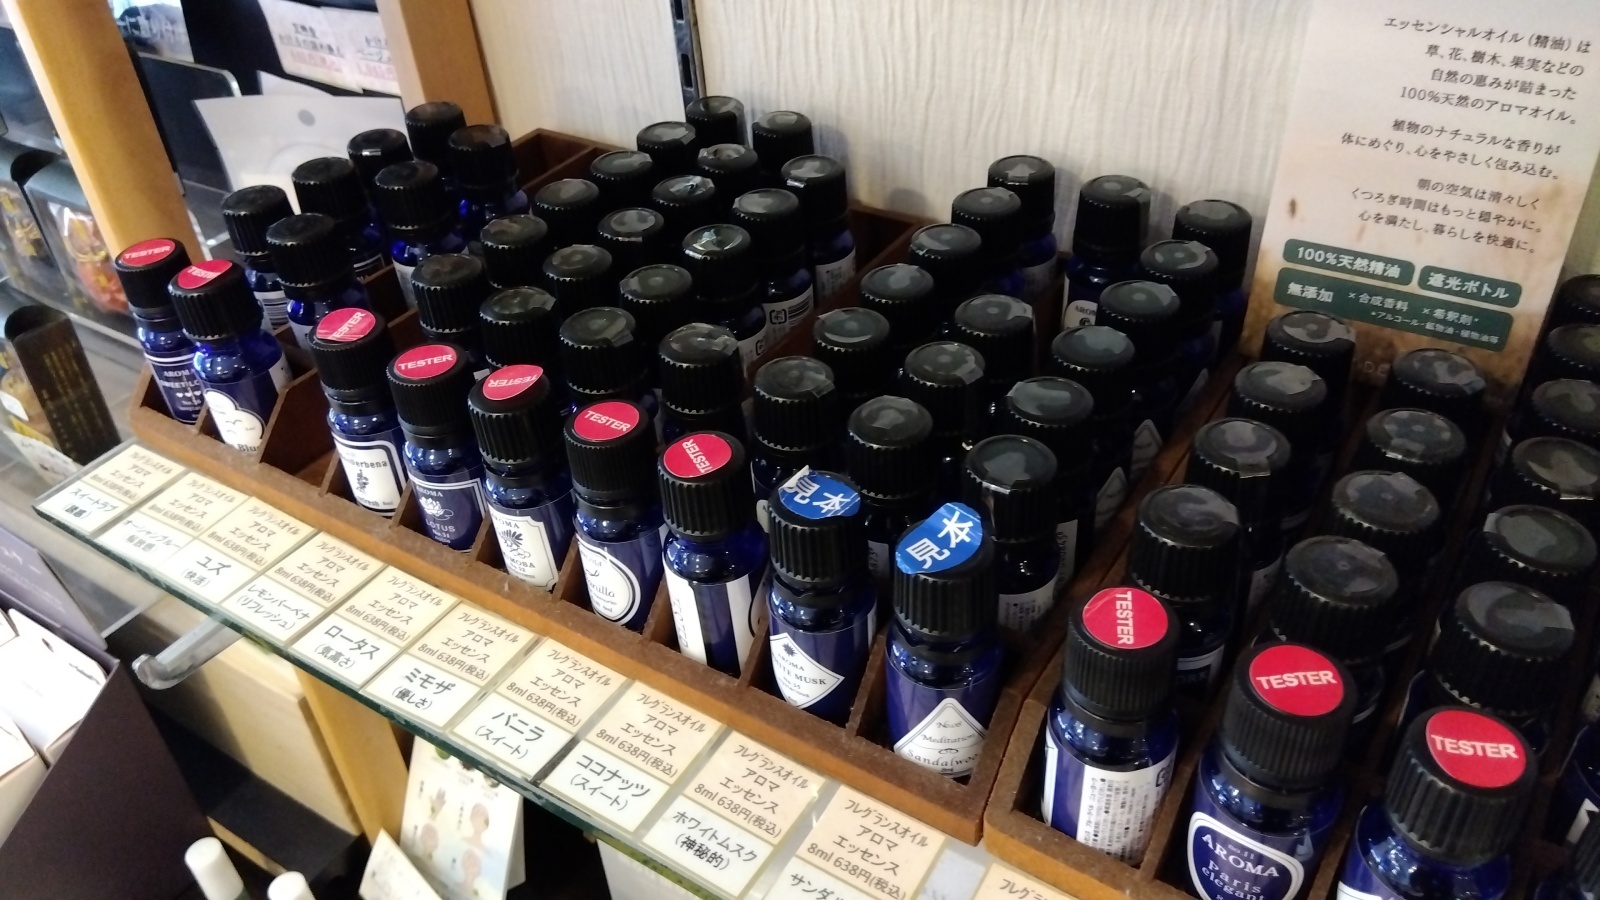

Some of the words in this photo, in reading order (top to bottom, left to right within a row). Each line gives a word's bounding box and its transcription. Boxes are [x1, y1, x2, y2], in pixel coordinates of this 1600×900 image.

[1425, 44, 1585, 77] 草、花、樹木、果実などの
[1430, 68, 1577, 101] 自然の恵みが詰まった
[1399, 86, 1577, 125] 100%天然のアロマオイル。
[1392, 119, 1561, 156] 植物のナチュラルな香りが
[1341, 132, 1559, 180] 体にめぐり、心をやさしく包み込む。
[1417, 179, 1540, 210] 朝の空気は清々しく
[124, 245, 171, 259] TESTER
[1296, 246, 1401, 279] 100%天然精油
[1287, 282, 1334, 303] 無添加
[1427, 271, 1510, 299] 遮光ボトル
[398, 354, 453, 371] TESTER
[488, 374, 537, 388] TESTER
[584, 410, 631, 432] TESTER
[682, 438, 713, 474] TESTER
[70, 488, 119, 512] スイートラブ
[784, 475, 850, 514] 見本
[425, 518, 456, 533] LOTUS
[905, 511, 974, 569] 見本
[196, 556, 231, 577] ユズ
[297, 562, 340, 588] エッセンス
[316, 556, 345, 574] アロマ
[236, 595, 296, 631] (リフレッシュ)
[247, 583, 311, 621] レモンバーベナ
[345, 604, 363, 618] 8ml
[368, 599, 413, 626] エッセンス
[388, 592, 419, 610] アロマ
[1115, 590, 1135, 645] TESTER
[324, 625, 381, 661] ロータス
[456, 611, 519, 644] フレグランスオイル
[461, 629, 495, 648] アロマ
[314, 643, 355, 670] (気高さ)
[417, 642, 437, 658] 8ml
[436, 651, 490, 682] 638円(税込)
[440, 637, 491, 664] エッセンス
[404, 667, 456, 696] ミモザ
[546, 649, 612, 687] フレグランスオイル
[551, 667, 586, 690] アロマ
[794, 672, 827, 686] MUSK
[1255, 670, 1338, 690] TESTER
[392, 686, 433, 711] (優しさ)
[506, 681, 527, 700] 8ml
[526, 691, 582, 728] 638円(税込)
[530, 676, 582, 708] エッセンス
[491, 711, 546, 743] バニラ
[639, 692, 706, 734] フレグランスオイル
[642, 713, 680, 737] アロマ
[474, 726, 529, 759] (スイート)
[596, 728, 618, 747] 8ml
[617, 739, 679, 778] 638円(税込)
[620, 722, 677, 757] エッセンス
[1430, 734, 1519, 759] TESTER
[576, 753, 651, 799] ココナッツ
[734, 743, 809, 790] フレグランスオイル
[741, 766, 781, 793] アロマ
[570, 773, 629, 811] (スイート)
[719, 776, 779, 815] エッセンス
[694, 783, 718, 804] 8ml
[717, 795, 782, 839] 638円(税込)
[844, 799, 929, 848] フレグランスオイル
[672, 810, 758, 864] ホワイトムスク
[675, 832, 731, 871] (神秘的)
[855, 824, 900, 852] アロマ
[807, 841, 833, 866] 8ml
[833, 855, 907, 900] 638円(税込)
[832, 834, 901, 877] エッセンス
[1201, 833, 1280, 877] AROMA
[789, 872, 844, 900] サンダ
